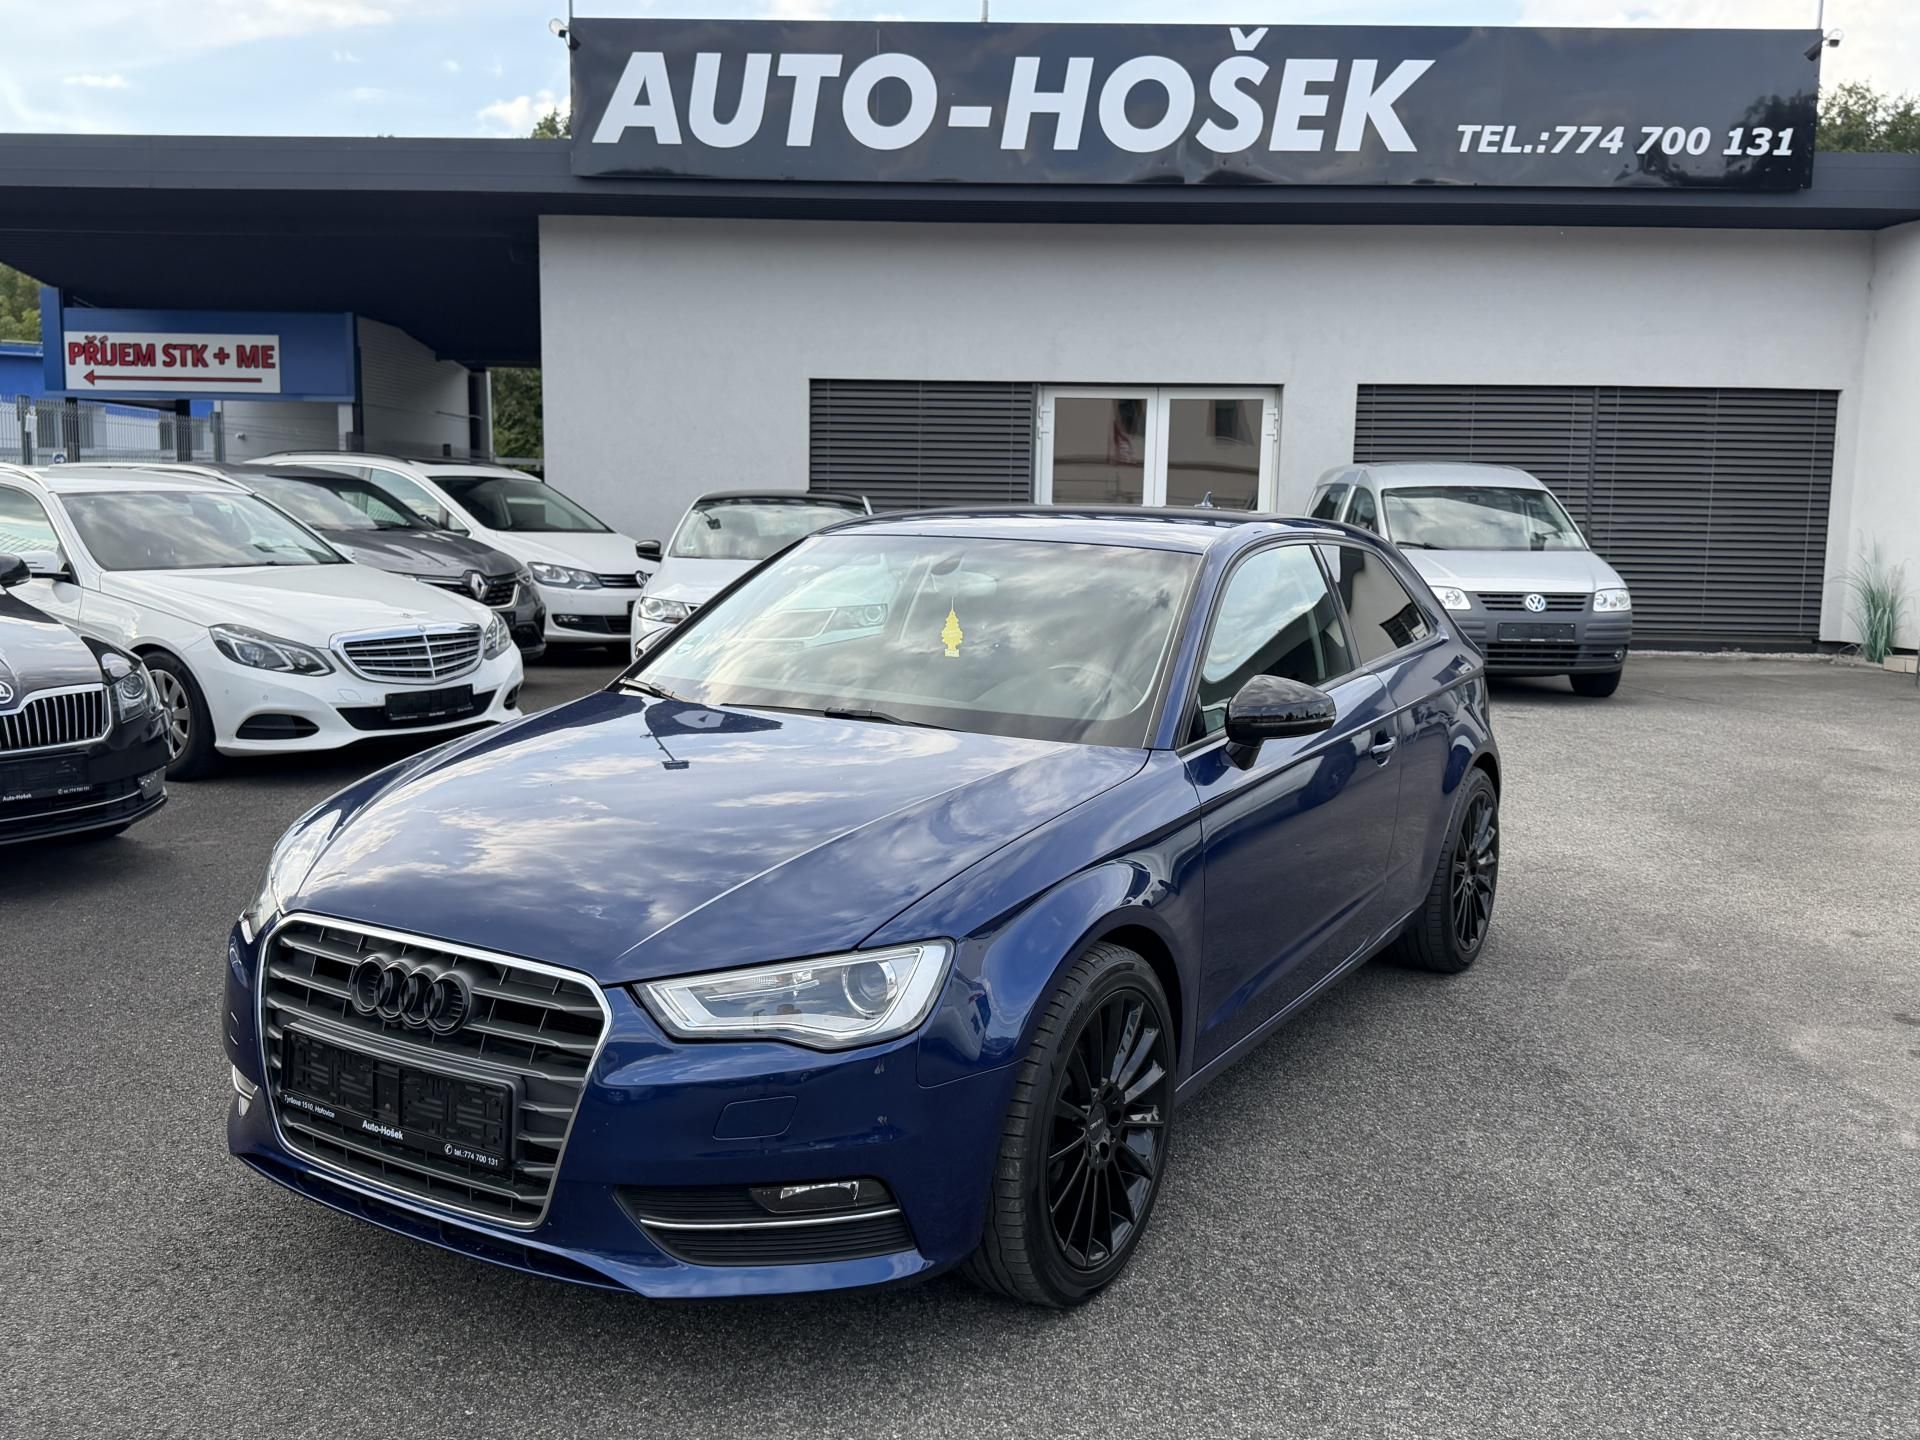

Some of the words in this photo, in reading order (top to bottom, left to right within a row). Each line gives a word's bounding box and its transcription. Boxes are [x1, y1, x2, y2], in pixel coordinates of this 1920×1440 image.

[592, 27, 1436, 153] AUTO-HOŠEK
[1458, 125, 1625, 155] TEL.:774
[1637, 126, 1712, 156] 700
[1723, 127, 1794, 156] 131
[68, 335, 156, 367] PŘÍJEM
[162, 343, 209, 368] STK
[236, 344, 276, 369] ME
[362, 1119, 404, 1140] Auto-Hošek
[475, 1153, 487, 1164] 700
[487, 1157, 499, 1167] 131
